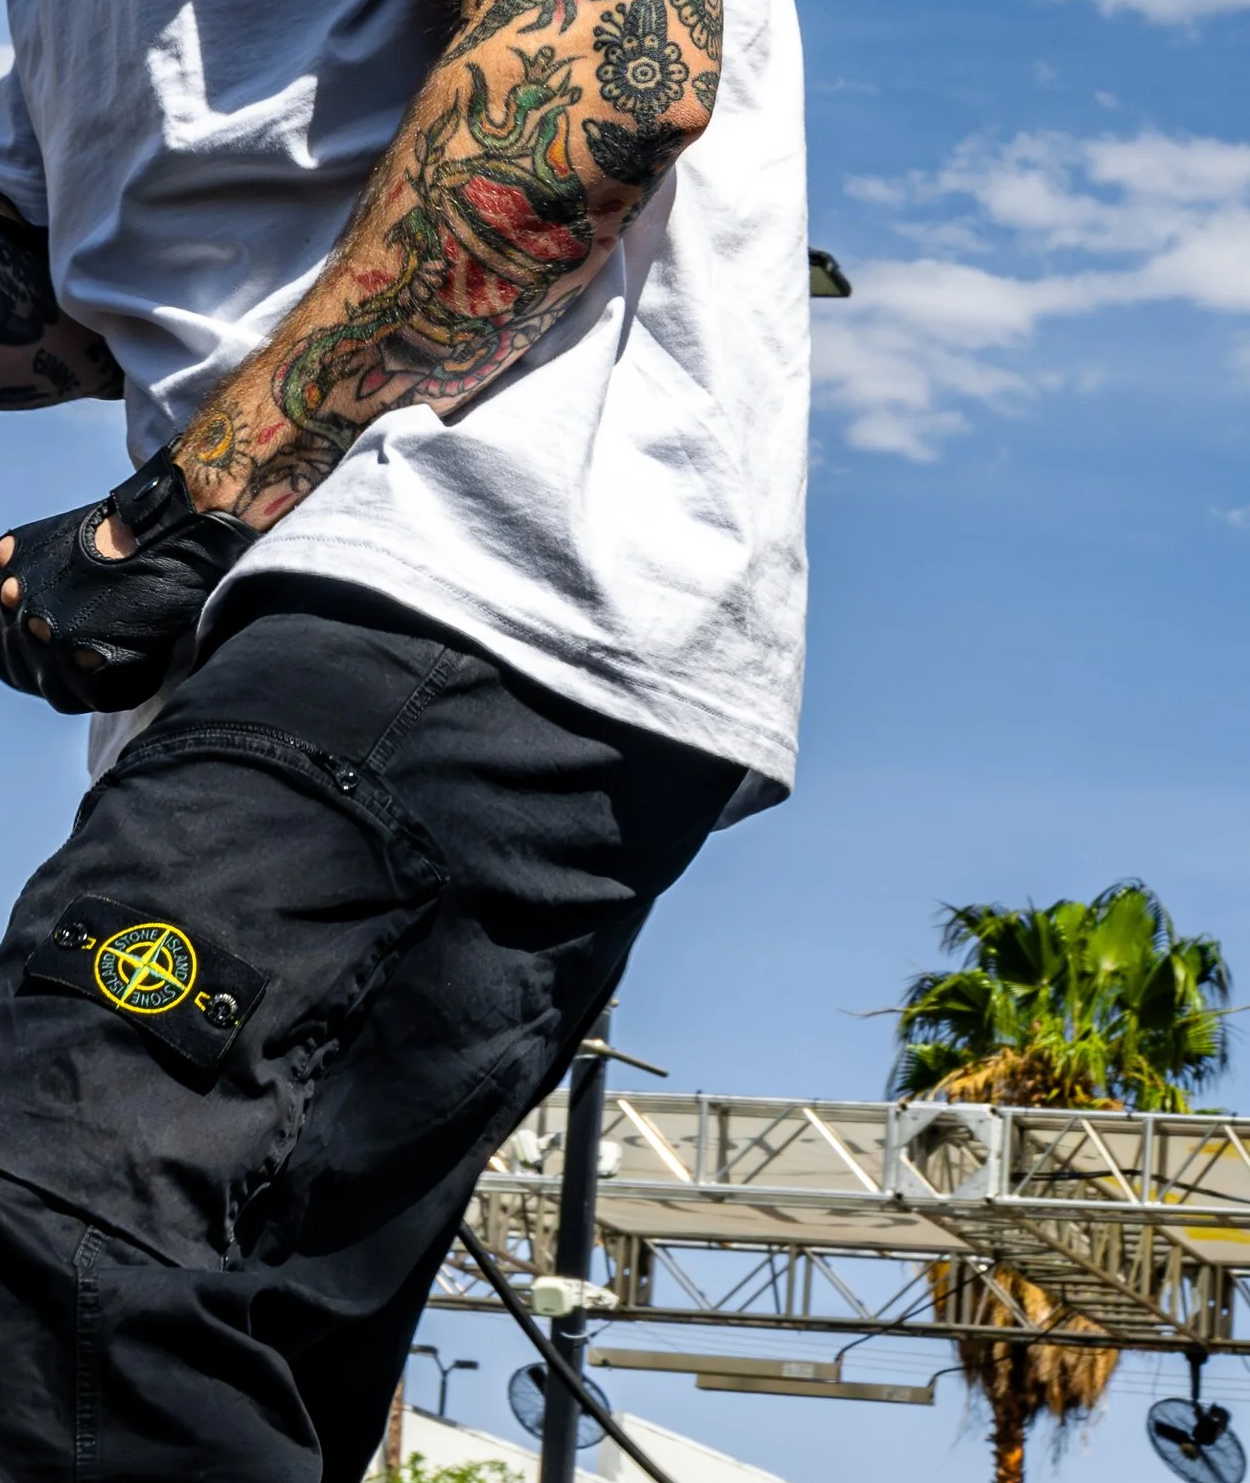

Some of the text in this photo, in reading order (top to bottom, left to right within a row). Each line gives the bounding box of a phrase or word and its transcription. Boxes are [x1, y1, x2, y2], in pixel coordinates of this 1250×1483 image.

[101, 953, 176, 1006] STONE ISLAND
[115, 928, 188, 981] STONE ISLAND
